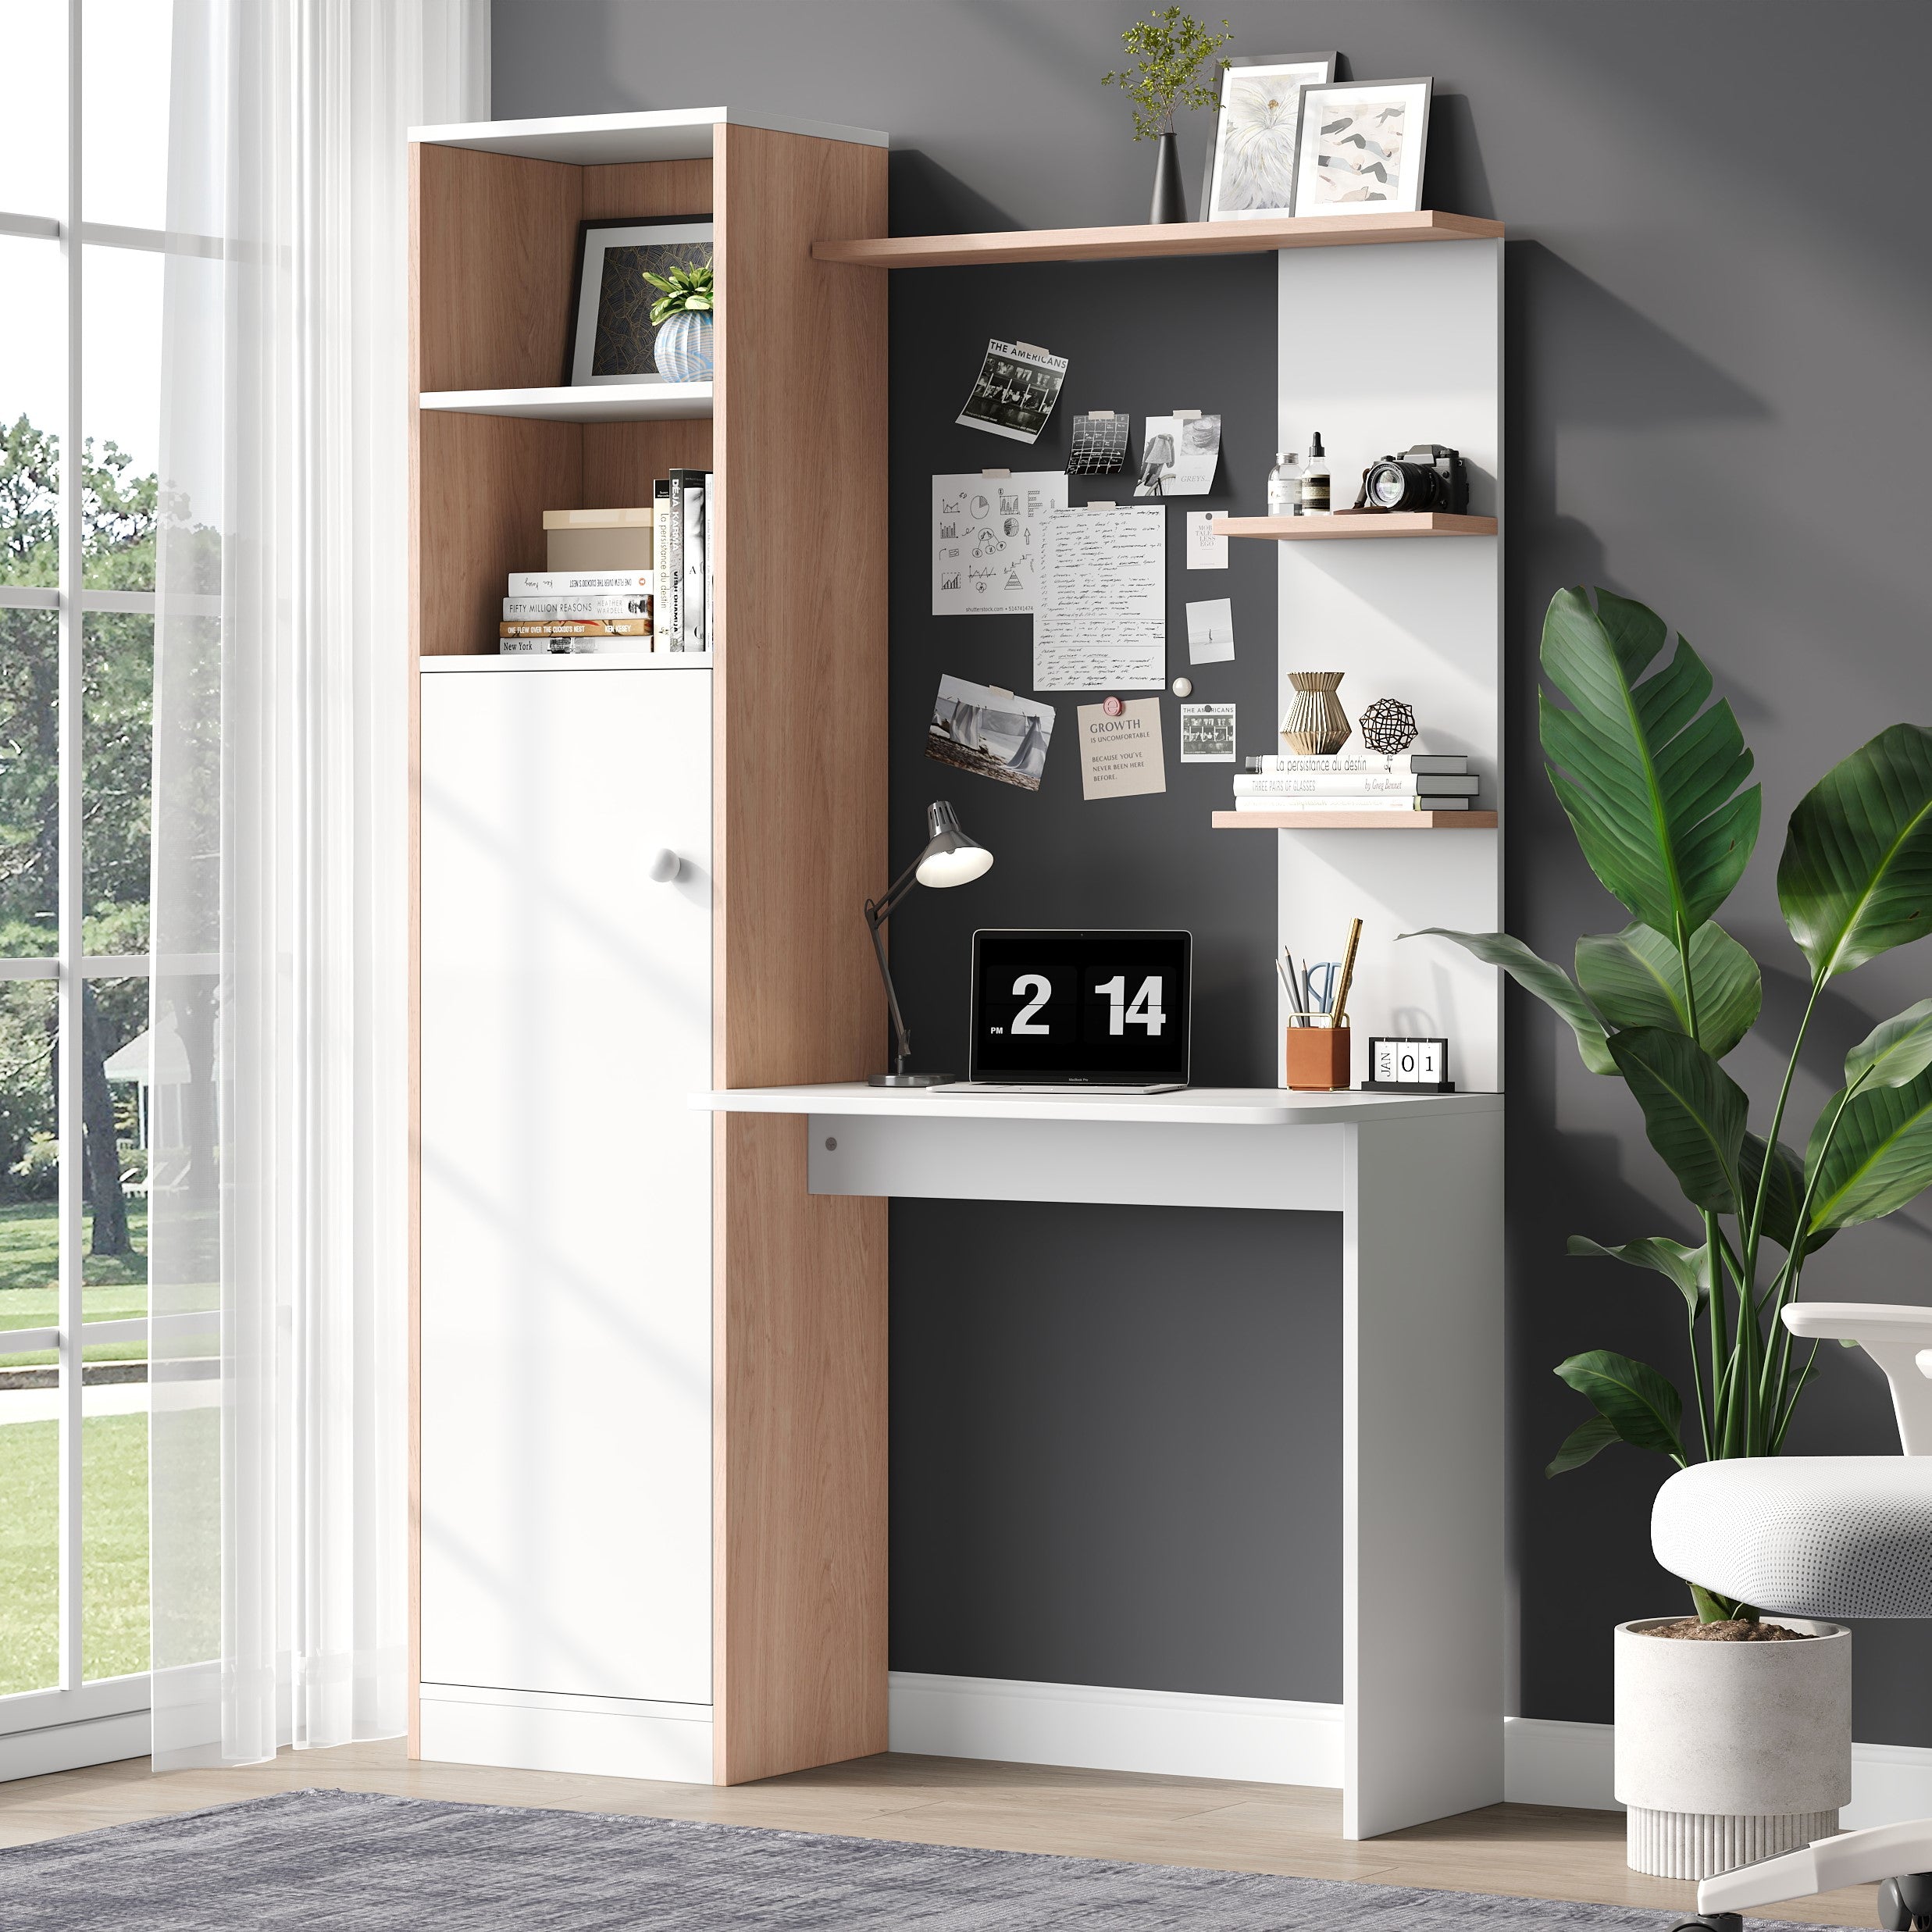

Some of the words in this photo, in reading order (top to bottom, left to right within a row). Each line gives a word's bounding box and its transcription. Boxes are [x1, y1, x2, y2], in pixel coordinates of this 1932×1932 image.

[991, 341, 1008, 353] THE
[1011, 348, 1067, 369] AMERICANS
[660, 513, 669, 522] La
[658, 525, 669, 570] persistance
[569, 579, 579, 588] NEST
[661, 572, 670, 583] du
[661, 585, 670, 608] destin
[509, 604, 527, 613] FIFTY
[529, 604, 558, 612] MILLION
[560, 603, 592, 611] REASONS
[504, 642, 517, 651] New
[519, 641, 533, 651] York
[1089, 718, 1140, 734] GROWTH
[1097, 732, 1150, 743] UNCOMFORTABLE
[1092, 754, 1117, 763] BECAUSE
[1276, 755, 1285, 772] La
[1287, 755, 1330, 774] persistance
[1331, 754, 1342, 771] du
[1344, 755, 1367, 771] destin
[1252, 780, 1268, 792] THREE
[1269, 780, 1284, 792] PAIRS
[1285, 780, 1292, 792] OF
[1292, 780, 1316, 792] GLASSES
[1364, 779, 1371, 792] by
[1371, 779, 1384, 792] Greg
[1385, 779, 1403, 790] Bennet
[1011, 974, 1052, 1035] 2
[1095, 975, 1166, 1036] 14
[1381, 1053, 1391, 1077] JAN
